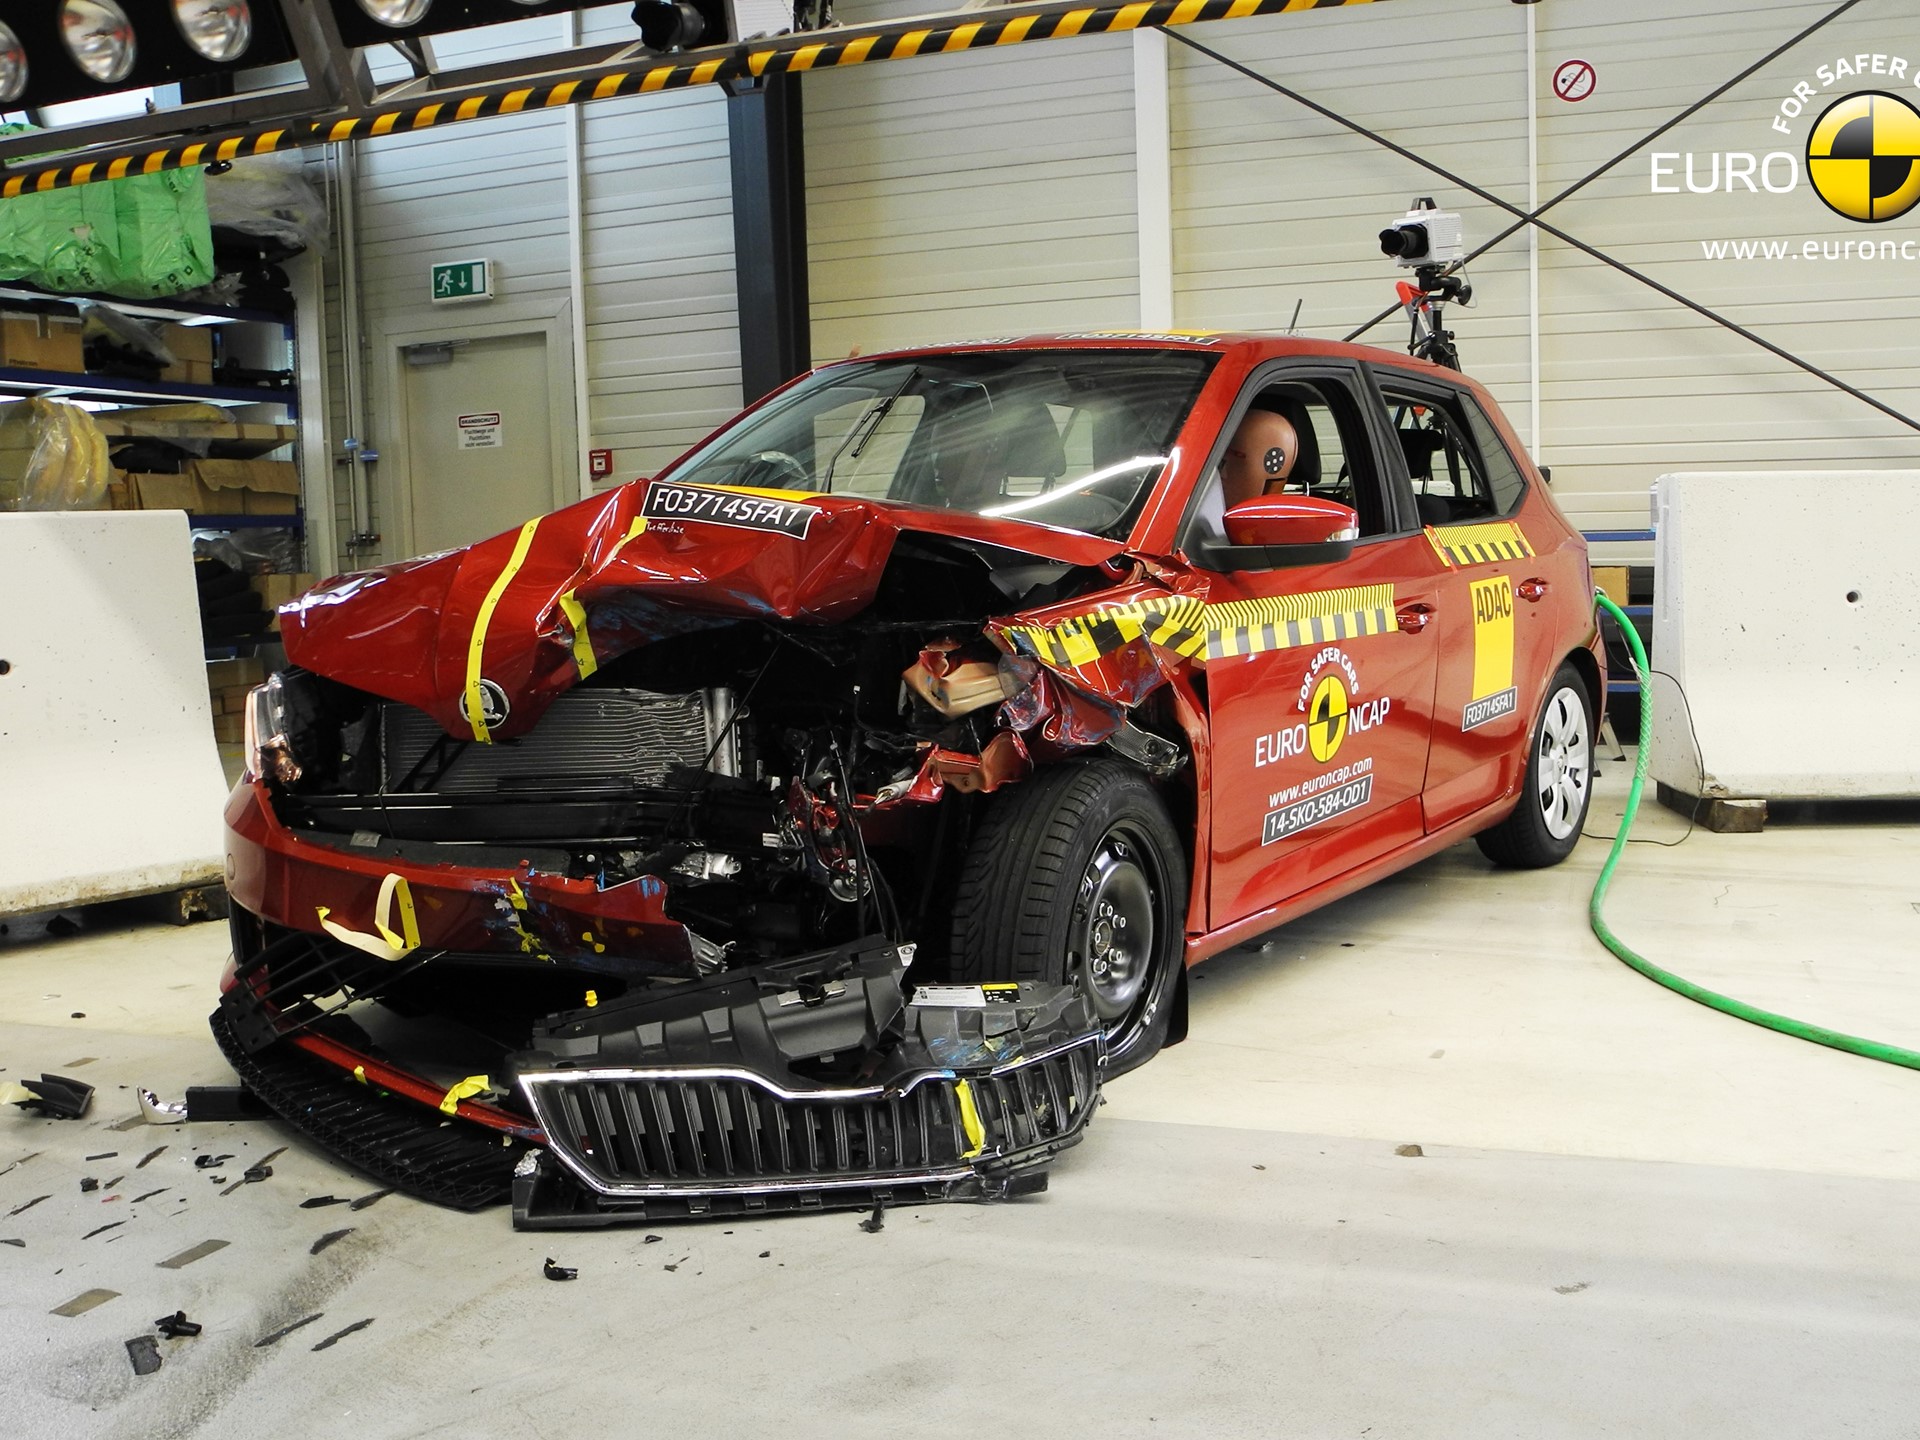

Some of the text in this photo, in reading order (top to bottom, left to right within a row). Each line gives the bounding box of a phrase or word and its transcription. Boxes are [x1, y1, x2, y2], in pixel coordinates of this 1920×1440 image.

[1475, 581, 1511, 625] ADAC
[1297, 647, 1359, 712] FOR SAFER CARS
[1348, 696, 1391, 736] NCAP
[1255, 723, 1307, 768] EURO
[1269, 757, 1373, 808] www.euroncap.com
